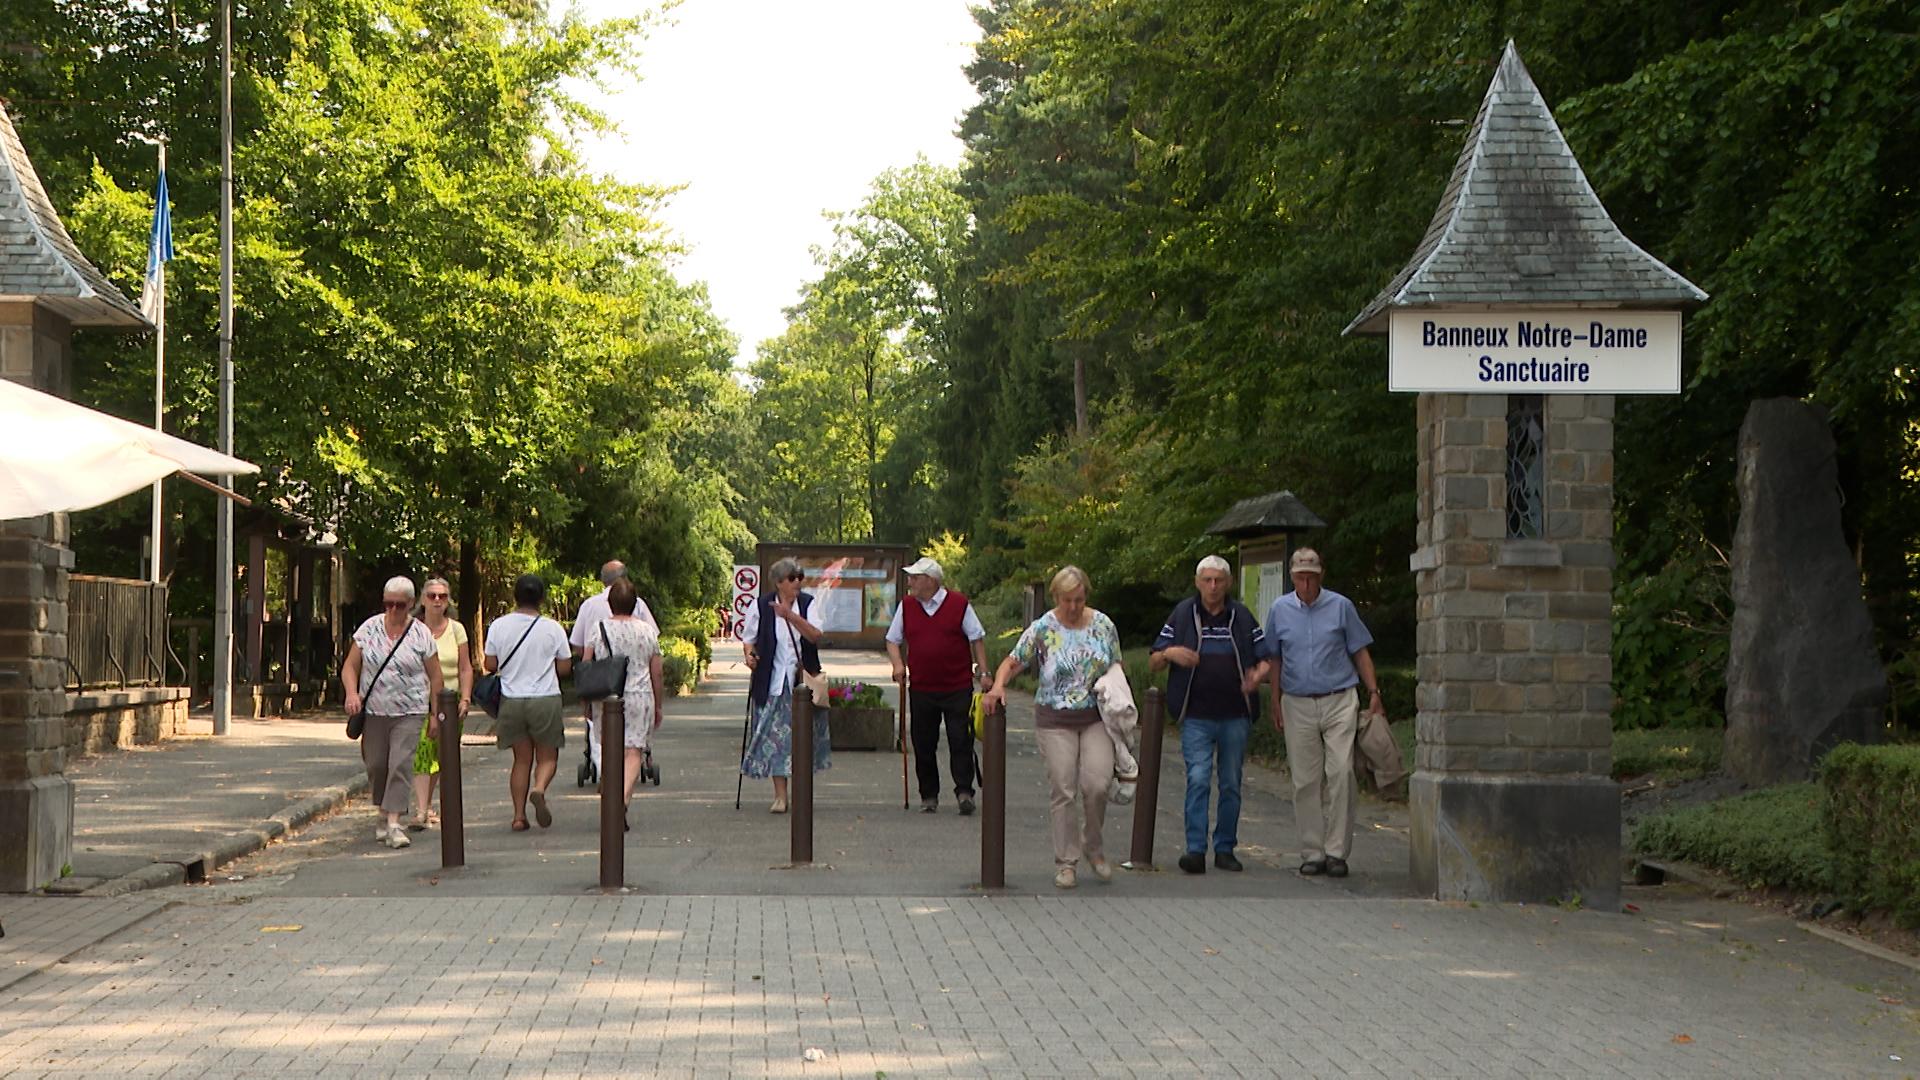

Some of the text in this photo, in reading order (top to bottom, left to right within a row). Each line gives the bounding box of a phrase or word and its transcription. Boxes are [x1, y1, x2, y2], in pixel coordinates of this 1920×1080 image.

[1422, 321, 1648, 348] Banneux Notre-Dame
[1478, 355, 1590, 382] Sanctuaire
